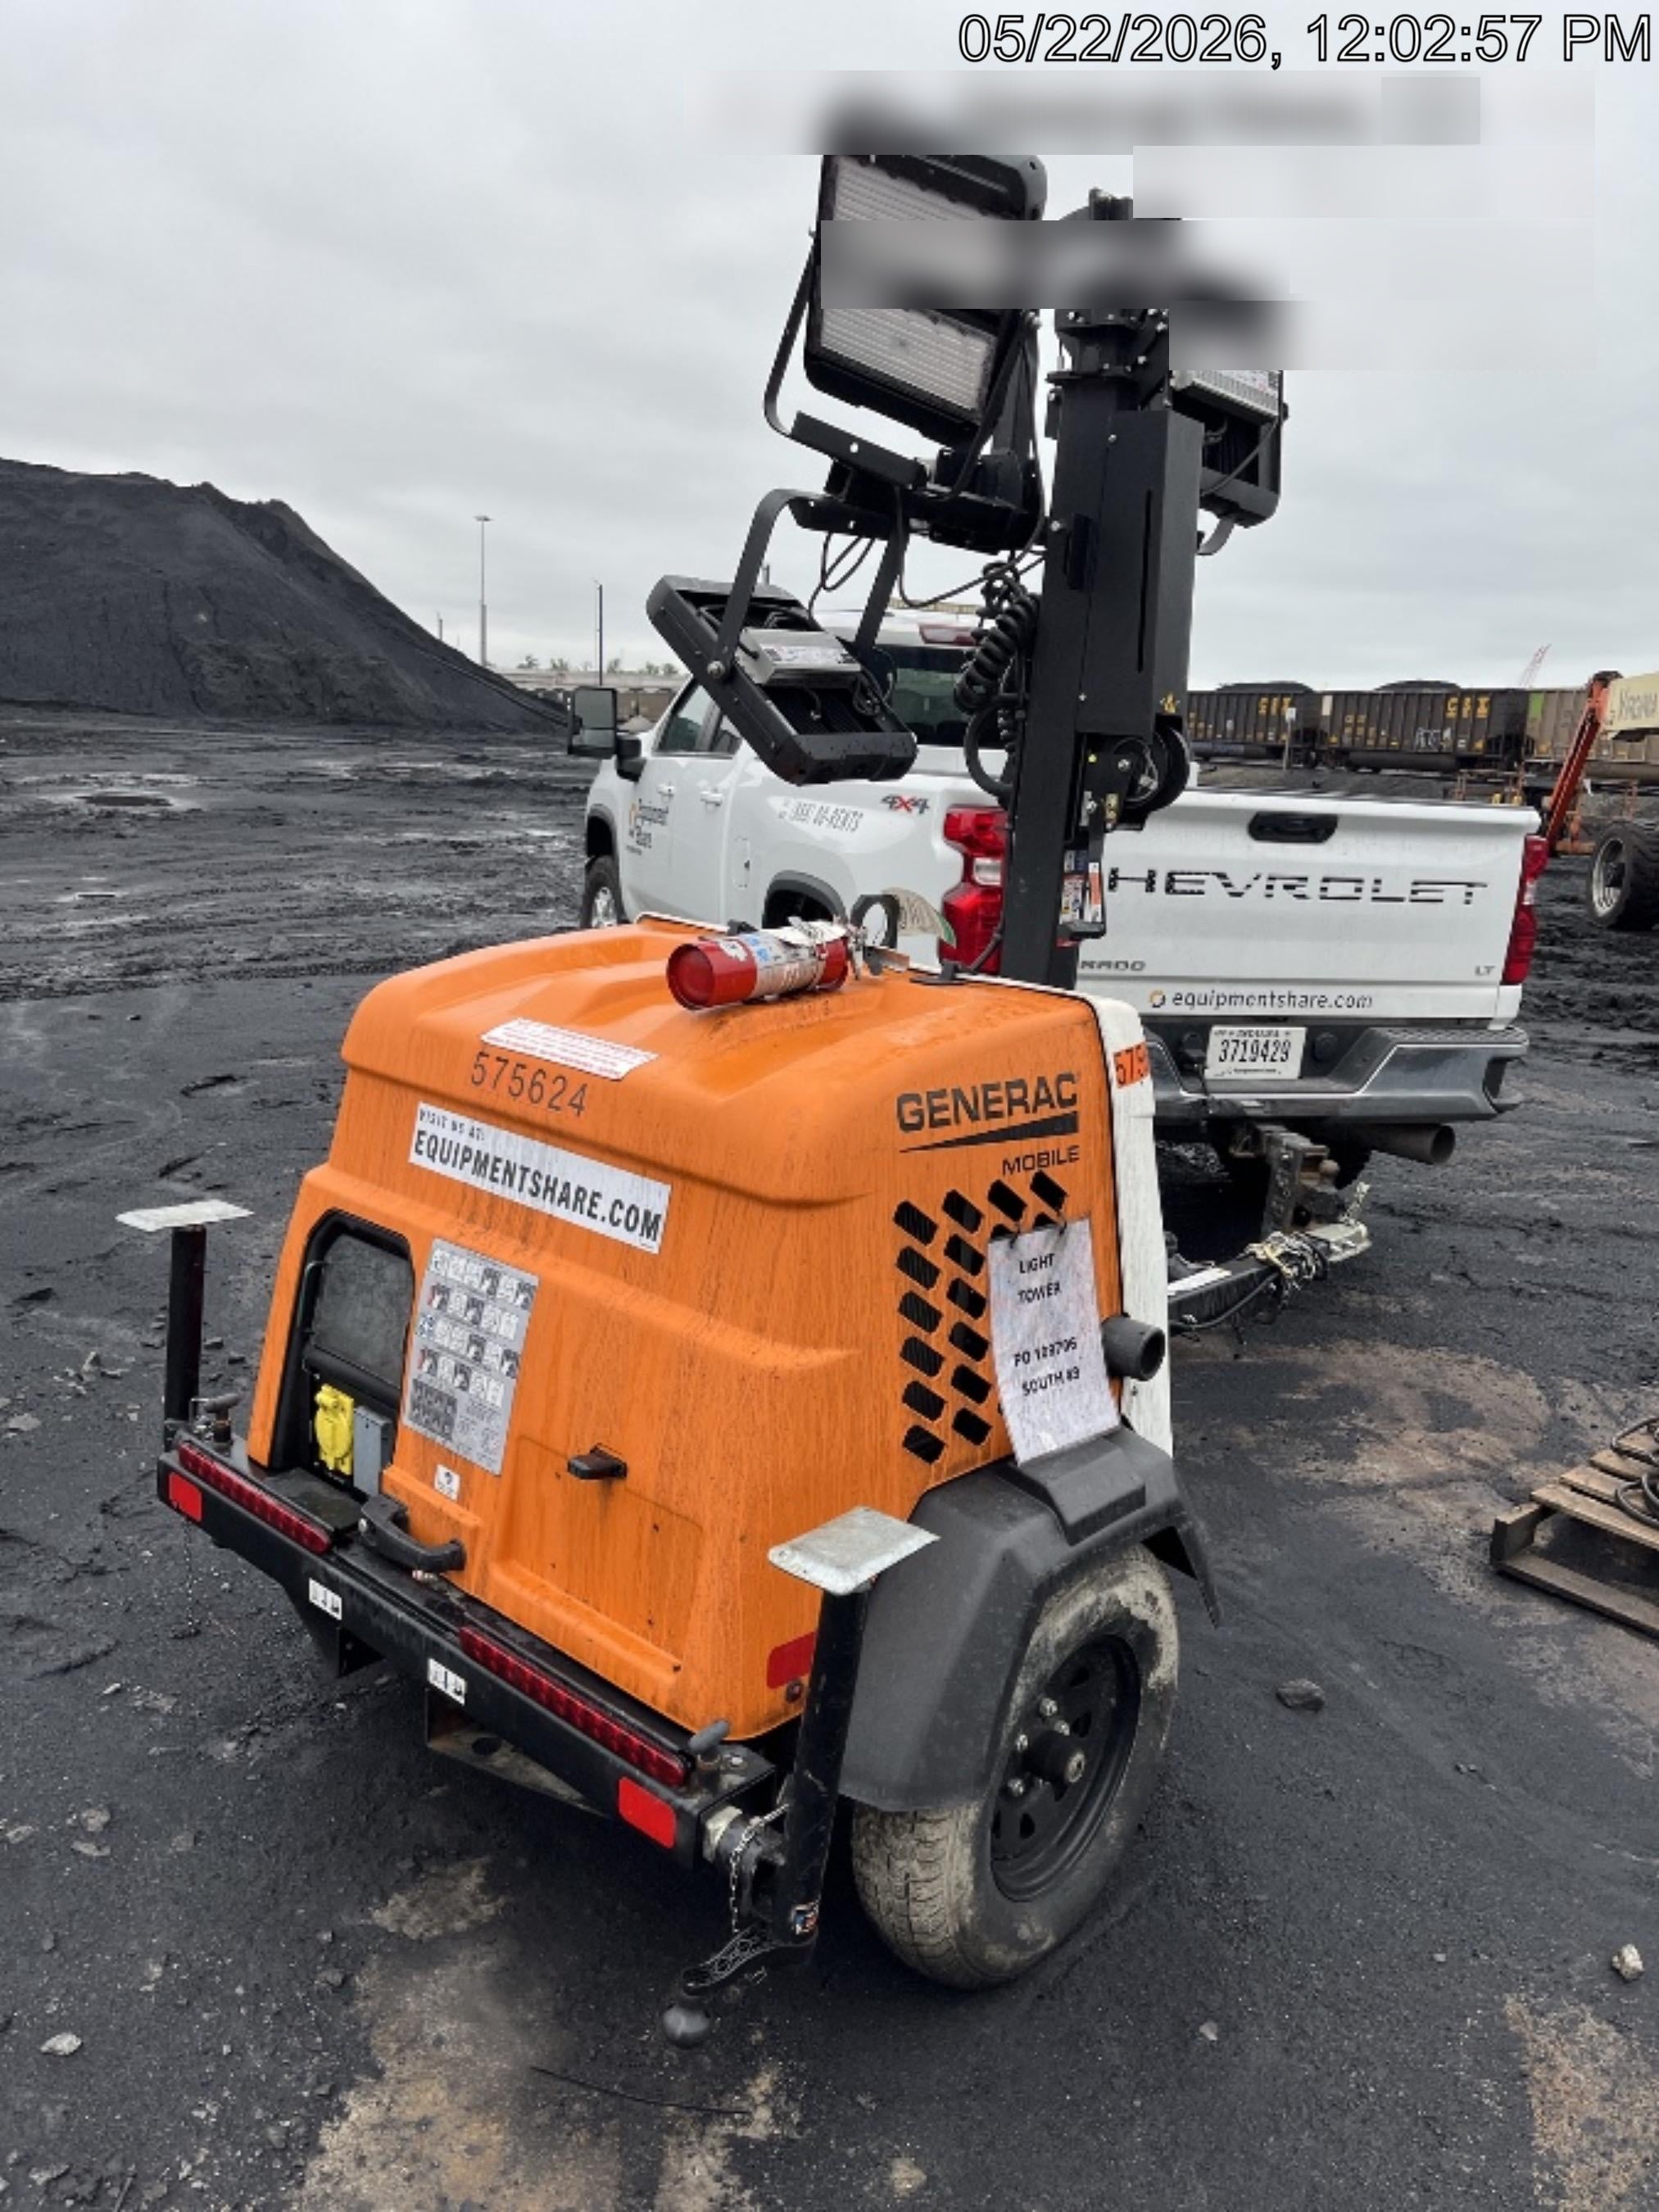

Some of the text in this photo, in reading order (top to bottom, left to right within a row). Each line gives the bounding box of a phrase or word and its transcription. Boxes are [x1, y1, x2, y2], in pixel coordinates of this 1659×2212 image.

[1108, 867, 1488, 905] HEVROLET
[1172, 990, 1373, 1011] equipmentshare.com
[472, 1051, 588, 1117] 575624
[897, 1072, 1077, 1133] GENERAC
[1002, 1145, 1080, 1175] MOBILE
[415, 1131, 661, 1241] EQUIPMENTSHARE.COM
[1019, 1253, 1055, 1274] LIGHT
[1018, 1281, 1061, 1304] TOWER
[1022, 1371, 1064, 1397] SOUTH
